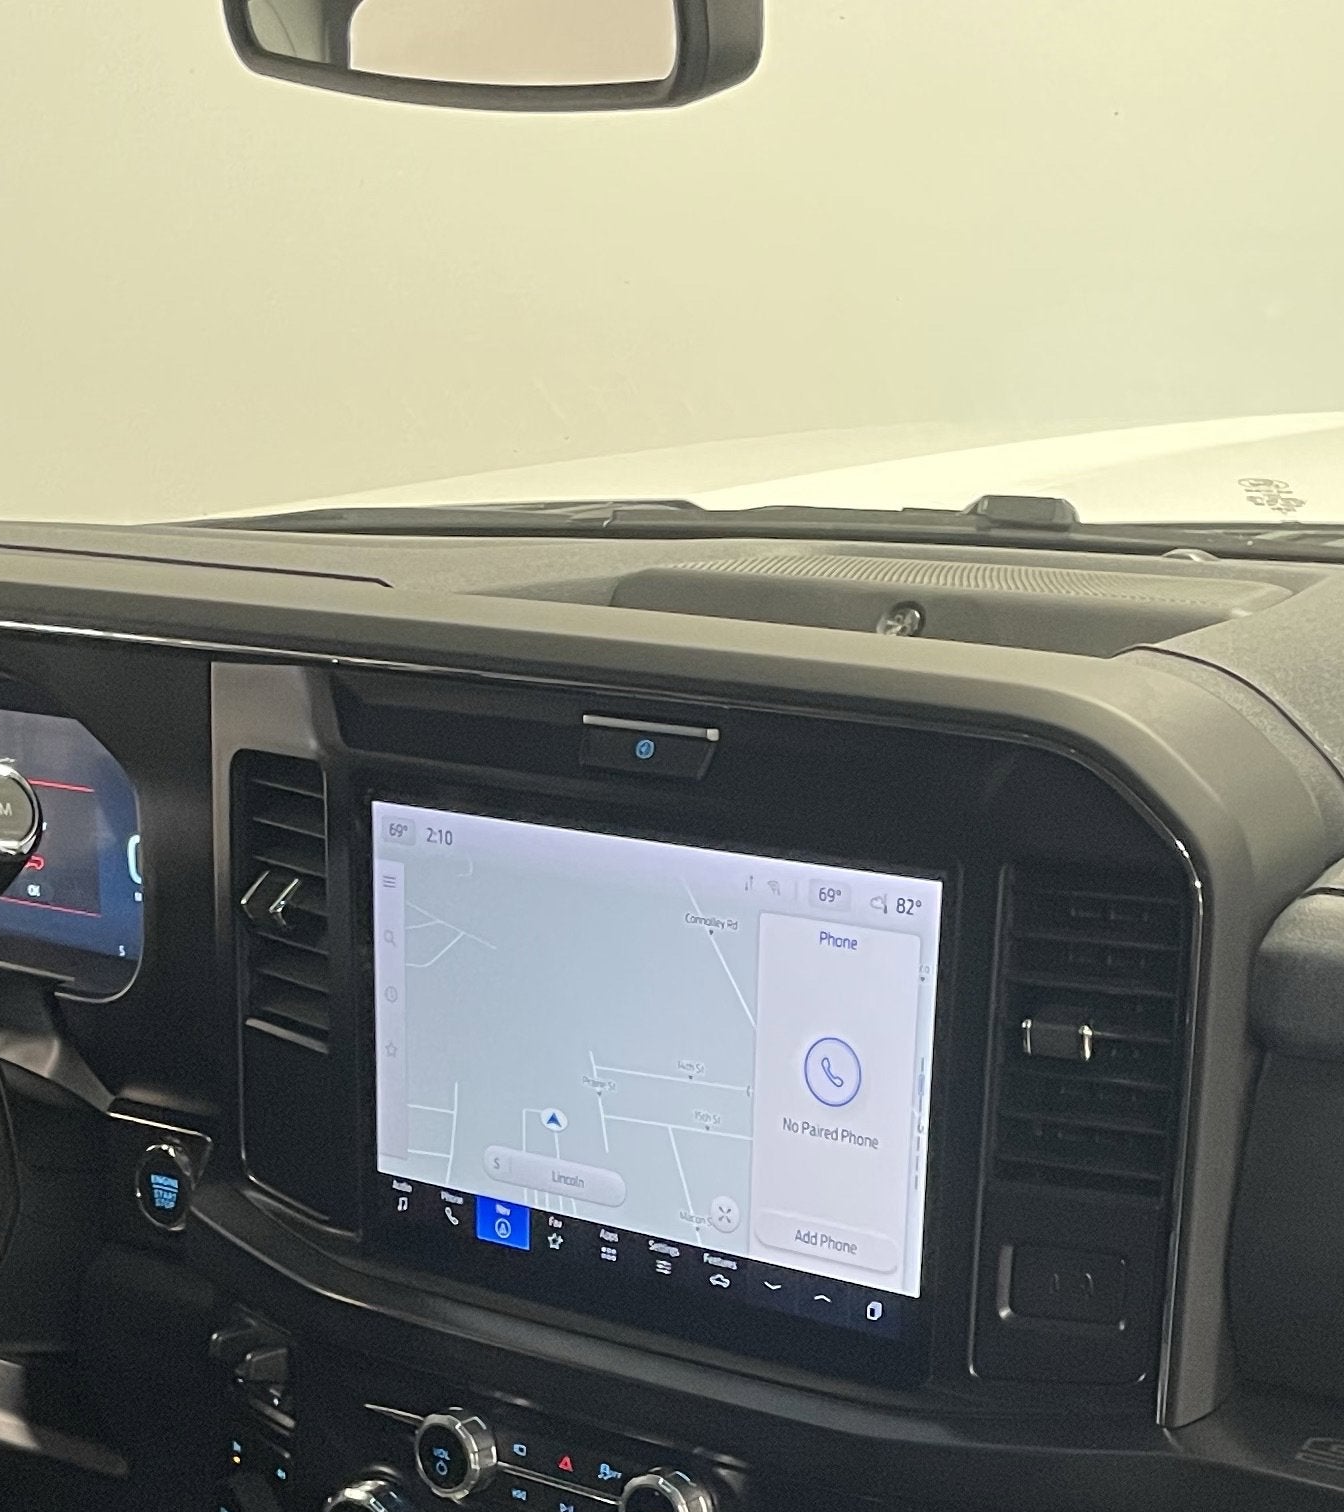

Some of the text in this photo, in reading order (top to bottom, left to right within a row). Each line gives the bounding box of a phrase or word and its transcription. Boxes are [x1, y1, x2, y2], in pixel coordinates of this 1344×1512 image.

[389, 822, 408, 838] 69°
[818, 887, 842, 903] 69°
[896, 896, 922, 916] 82°
[819, 930, 858, 951] Phone
[782, 1117, 879, 1150] No Paired Phone
[493, 1157, 501, 1170] S
[552, 1169, 585, 1189] Lincoln
[794, 1229, 858, 1255] Add Phone
